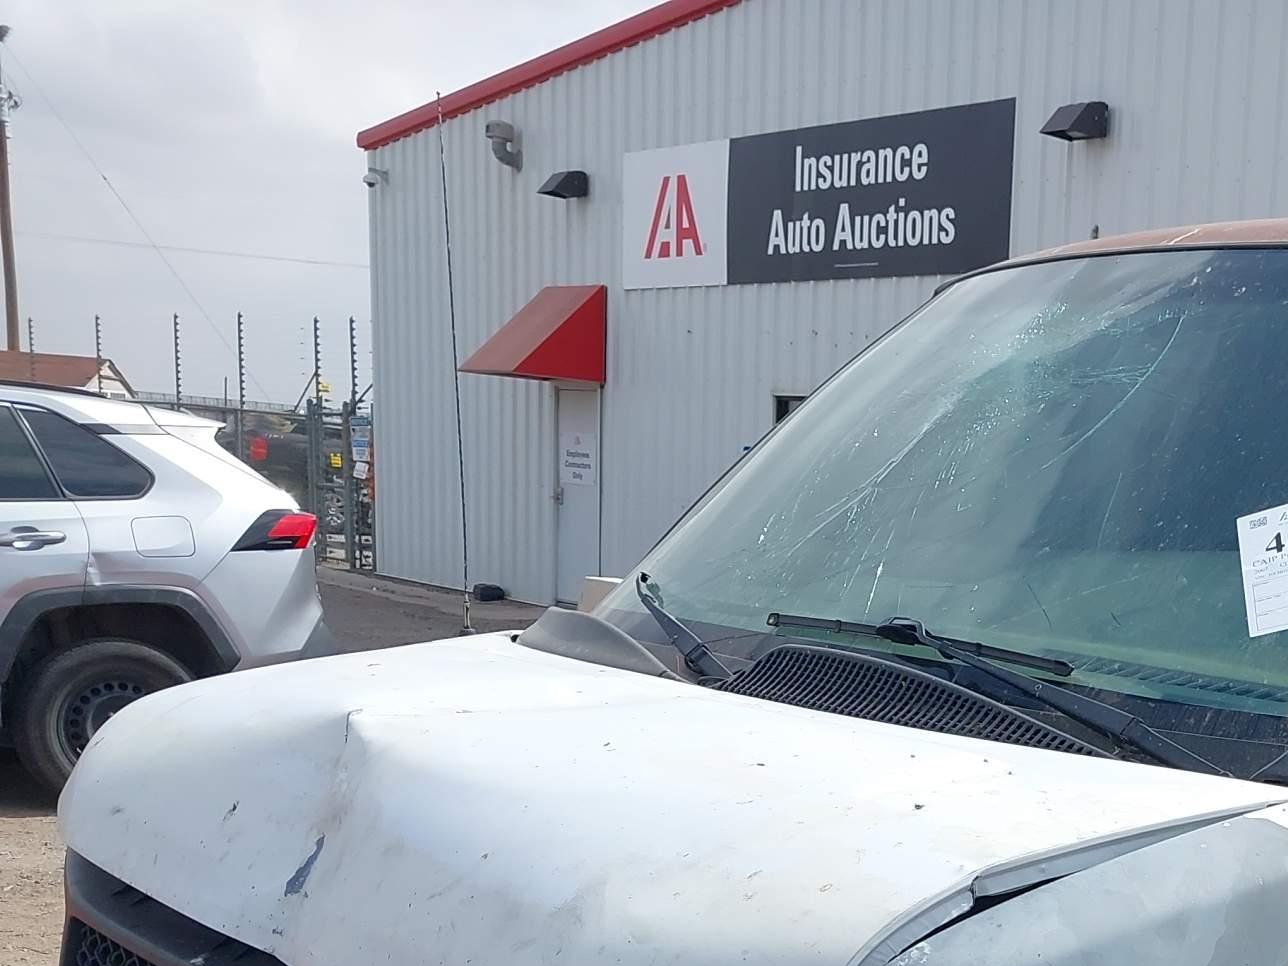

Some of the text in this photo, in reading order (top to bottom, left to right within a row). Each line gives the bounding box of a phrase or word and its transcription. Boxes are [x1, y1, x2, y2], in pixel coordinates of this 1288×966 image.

[795, 143, 929, 192] Insurance
[767, 198, 956, 256] Auto Auctions
